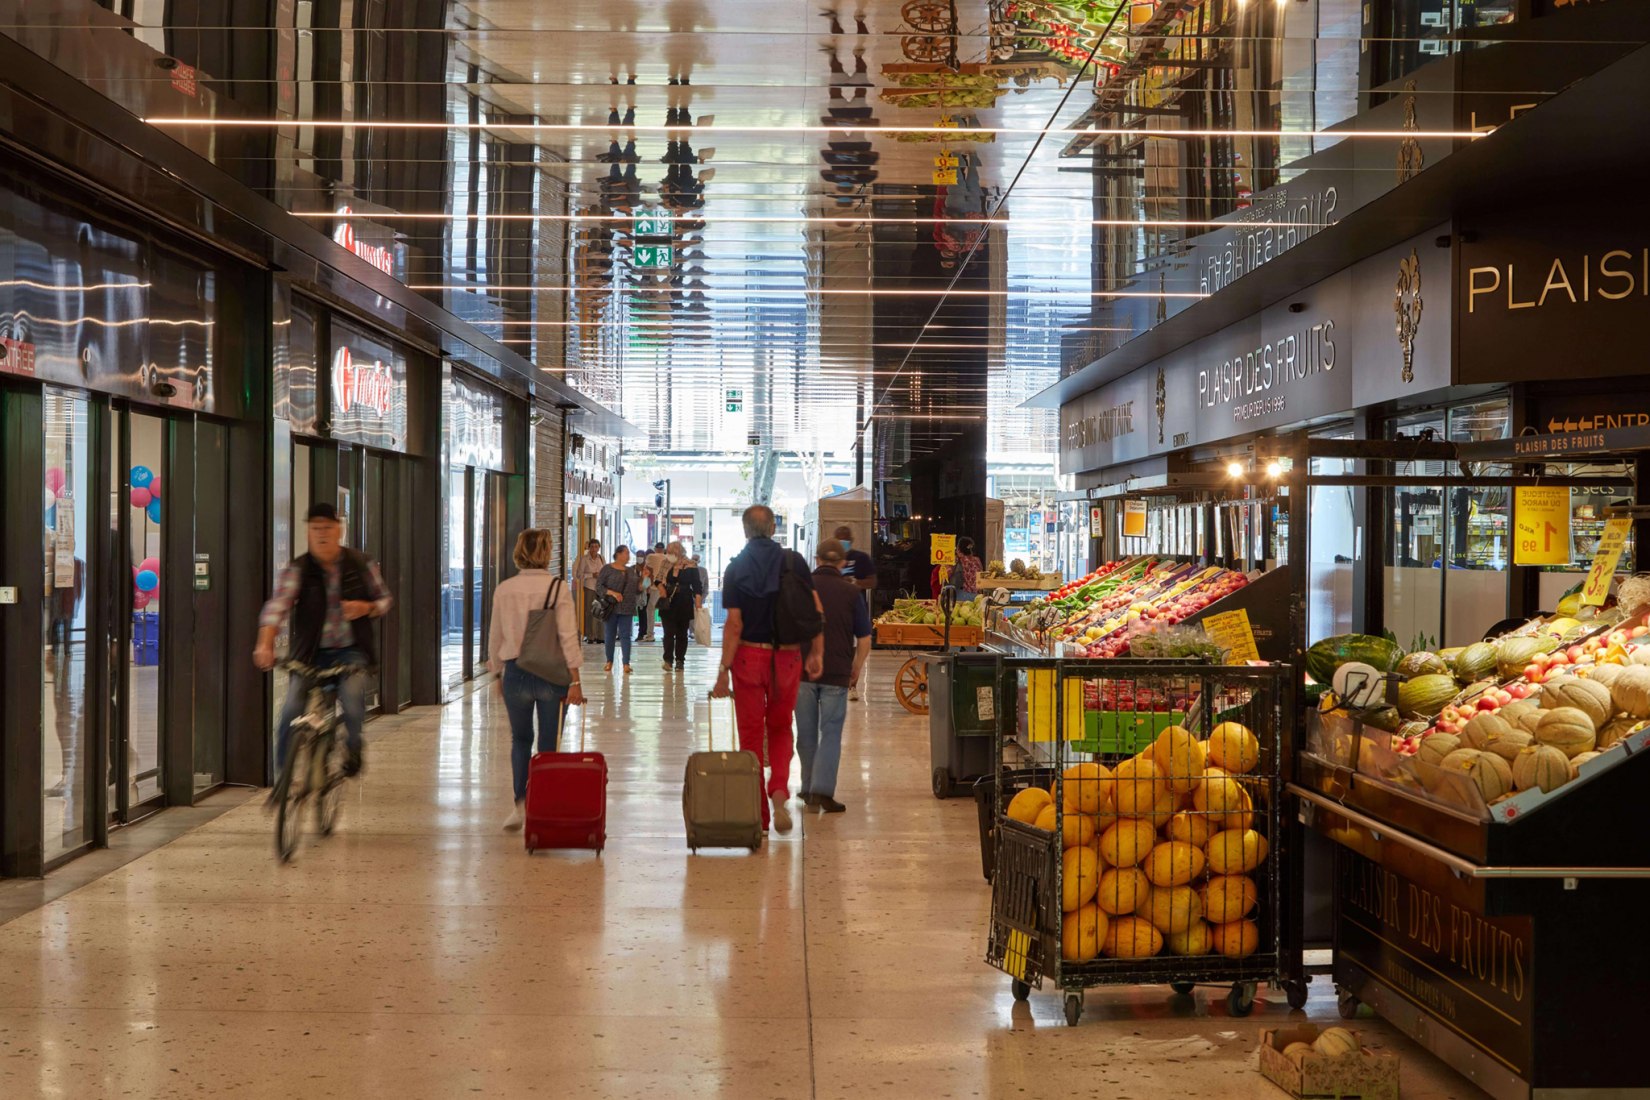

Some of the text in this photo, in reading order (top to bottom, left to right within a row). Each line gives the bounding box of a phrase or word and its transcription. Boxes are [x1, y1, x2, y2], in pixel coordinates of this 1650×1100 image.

[1468, 247, 1649, 313] PLAISI
[1199, 319, 1336, 409] PLAISIR DES FRUITS
[1098, 400, 1134, 443] AQUITAINE
[1253, 398, 1271, 417] DEPUIS
[1271, 395, 1286, 412] 1996
[1515, 434, 1605, 453] PLAISIR DES FRUITS
[935, 549, 943, 560] 0
[1587, 565, 1604, 596] 3
[1341, 851, 1525, 1003] PLAISIR DES FRUITS
